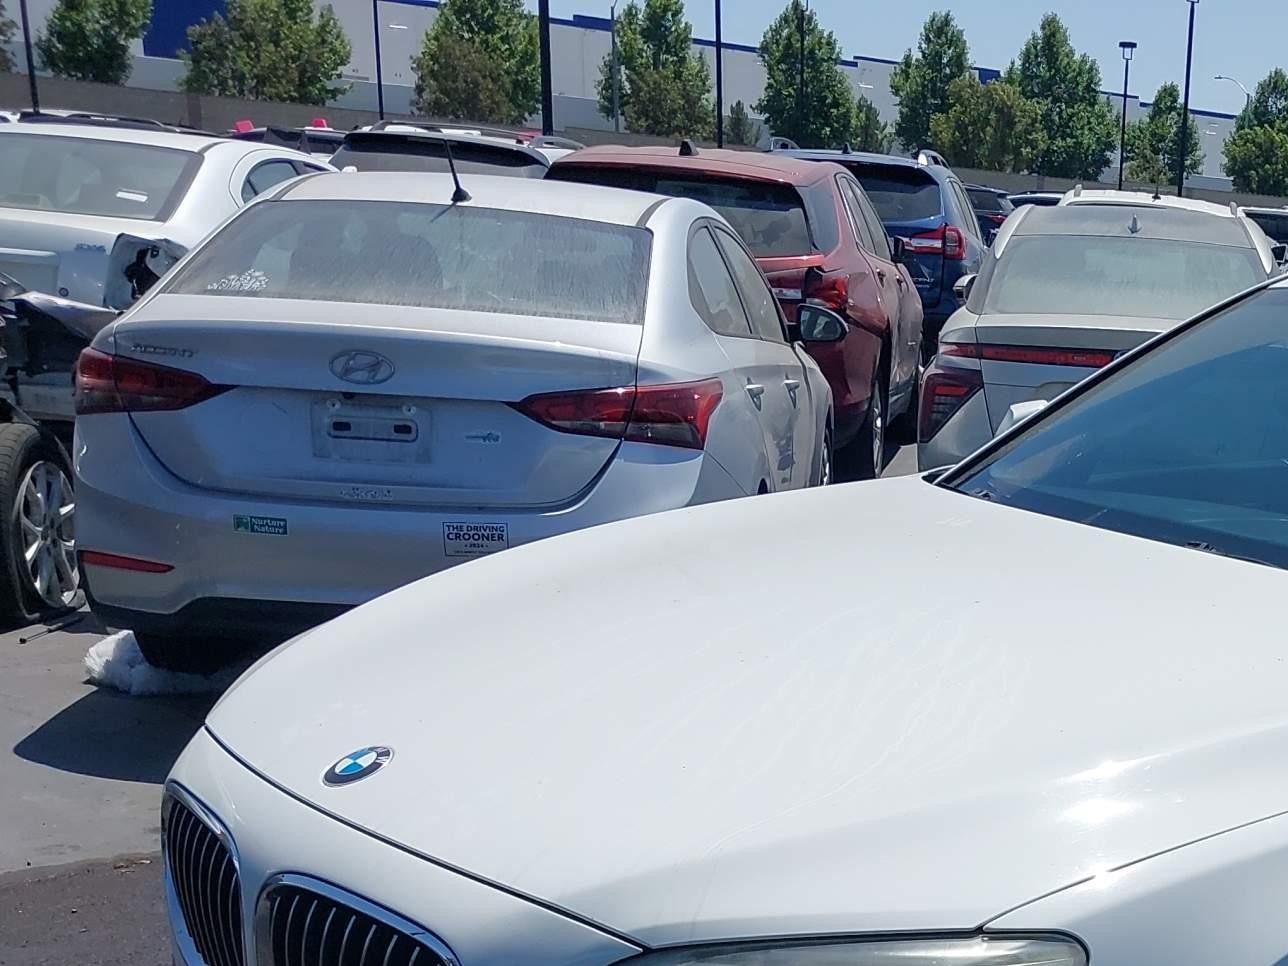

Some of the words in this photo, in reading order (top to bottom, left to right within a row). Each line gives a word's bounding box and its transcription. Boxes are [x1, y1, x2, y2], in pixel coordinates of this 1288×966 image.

[445, 524, 465, 532] THE
[466, 525, 505, 533] DRIVING
[446, 532, 505, 542] CROONER
